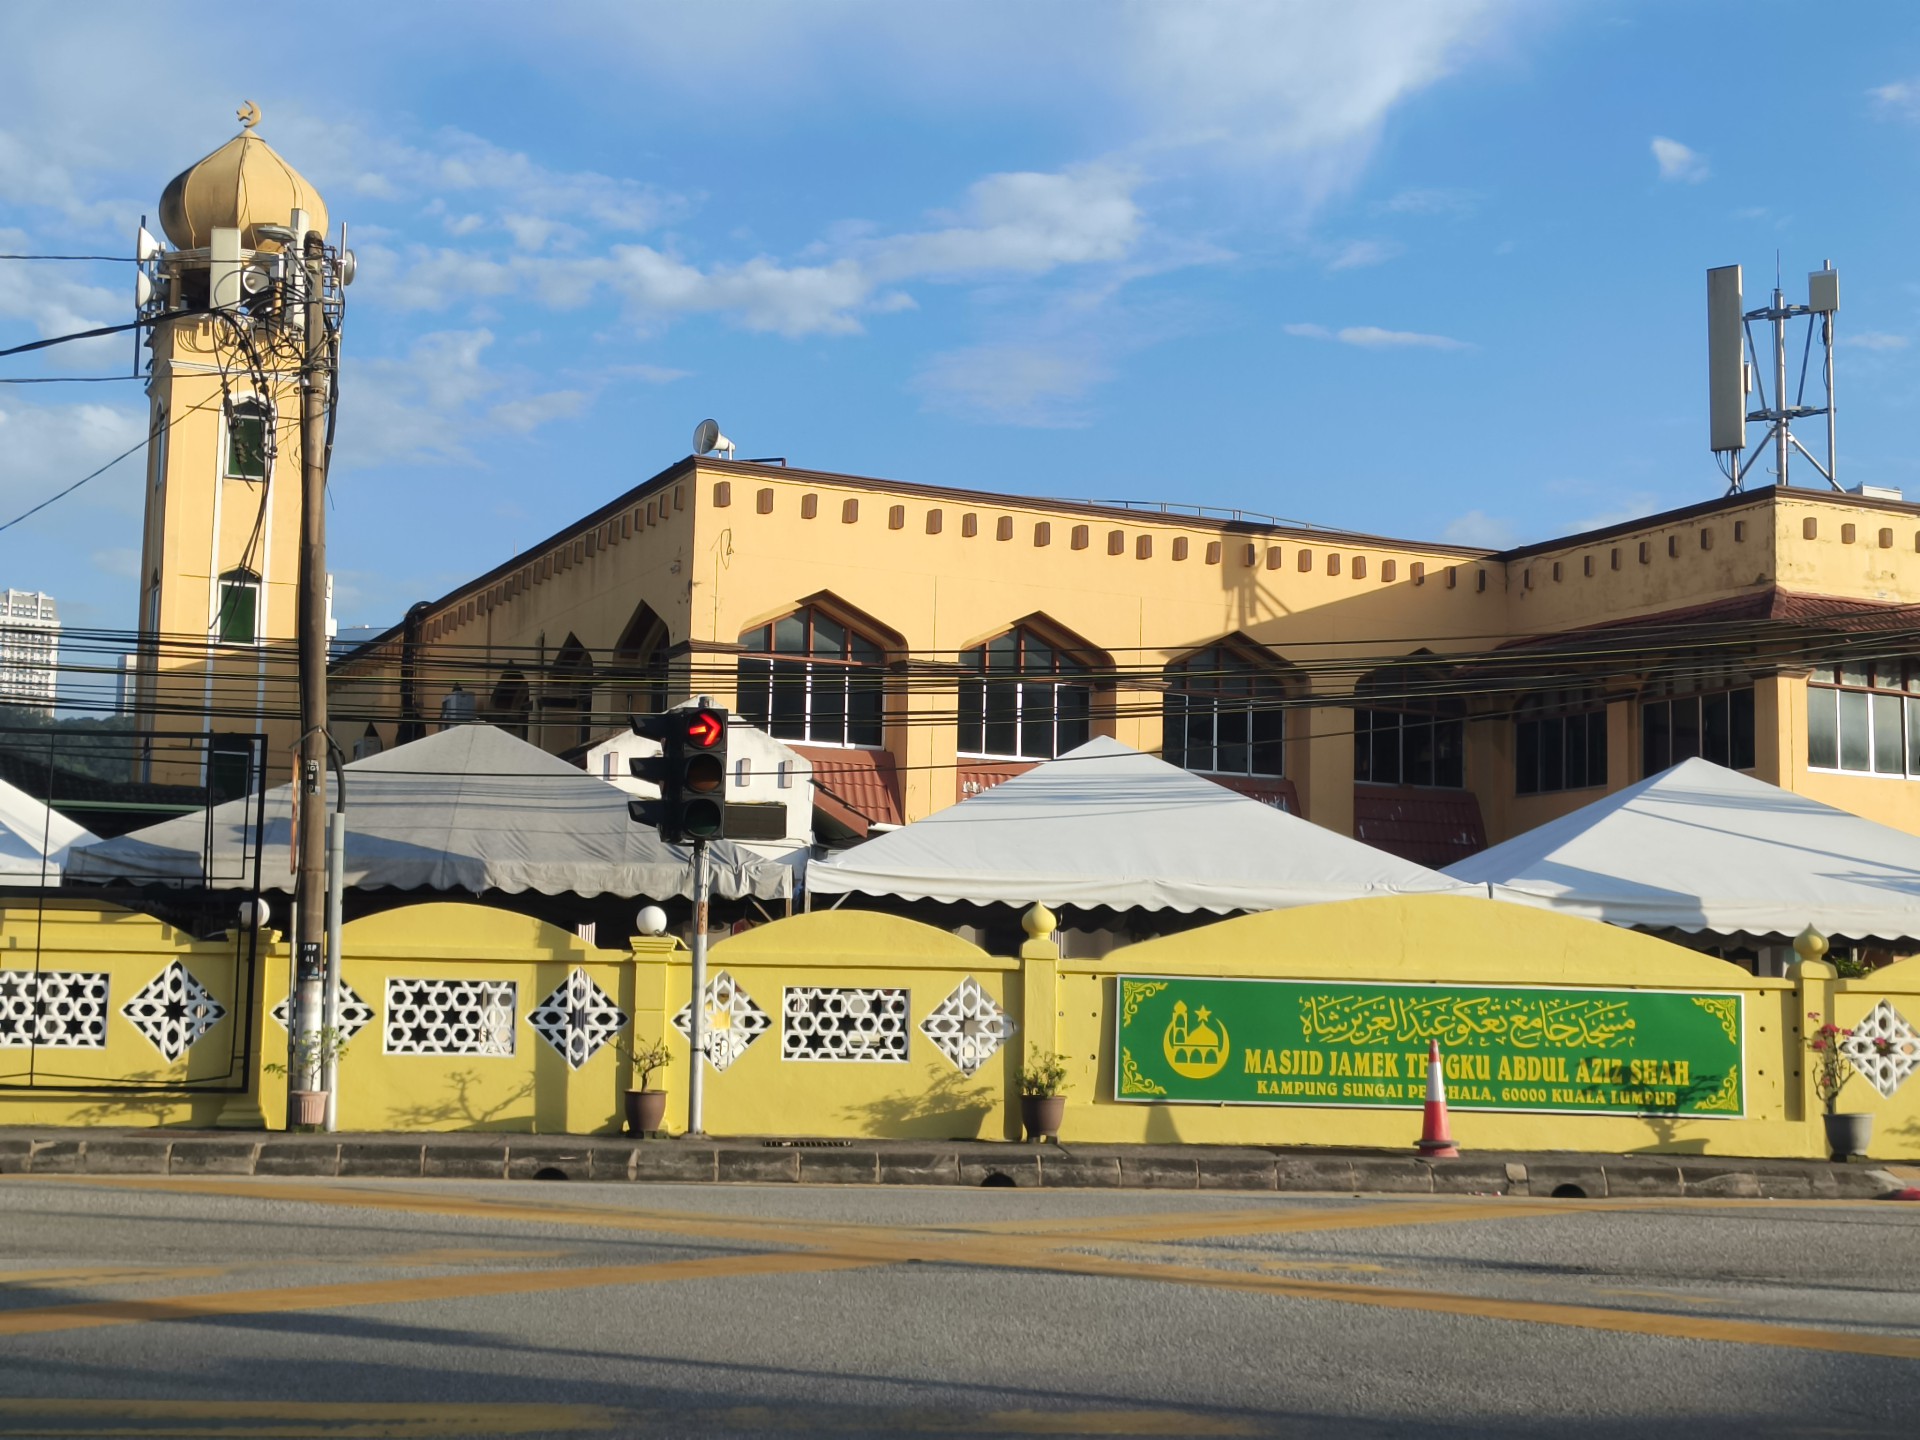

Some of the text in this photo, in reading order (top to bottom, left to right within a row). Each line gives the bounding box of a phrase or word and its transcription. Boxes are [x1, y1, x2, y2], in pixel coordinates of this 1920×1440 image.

[1244, 1048, 1690, 1086] MASJID JAMEK TEGKU ABDUL AZIZ SHAH
[1257, 1080, 1677, 1106] KAMPUNG SUNGAI PEHALA, 60000 KUALA LUMPUR
